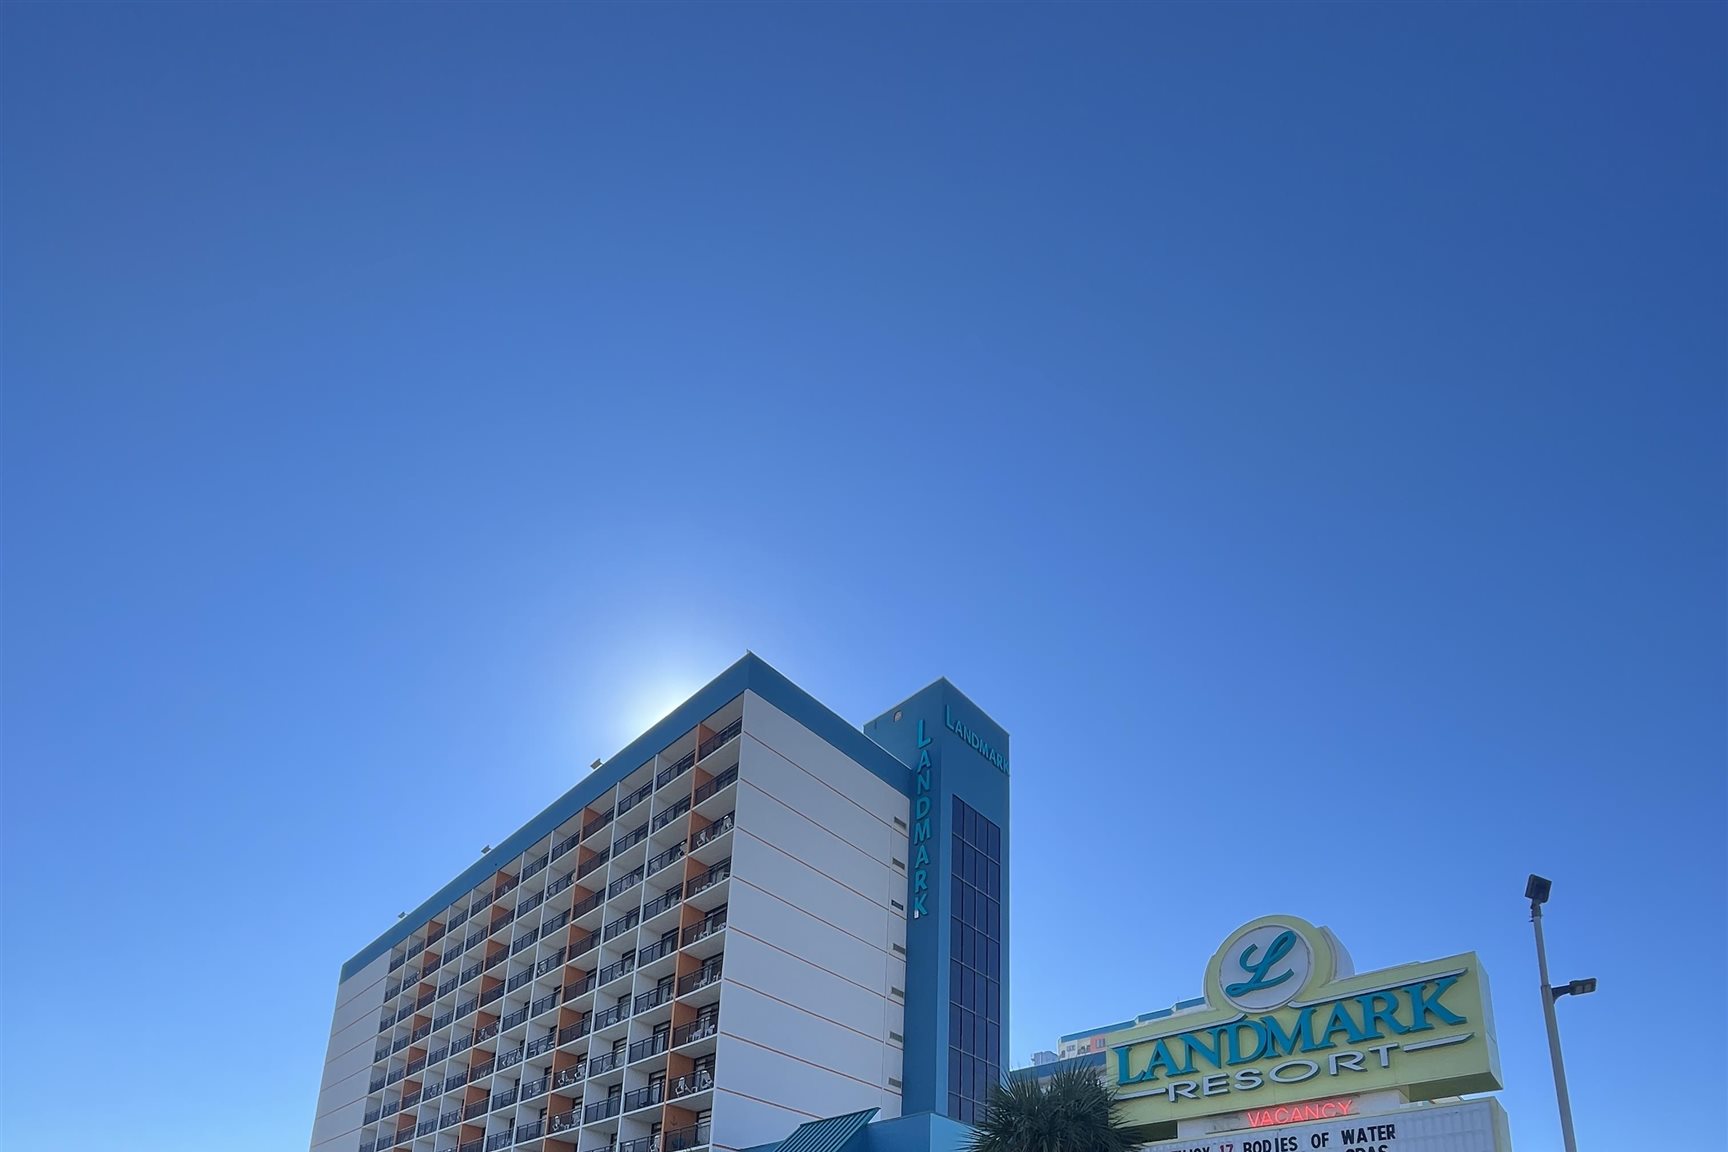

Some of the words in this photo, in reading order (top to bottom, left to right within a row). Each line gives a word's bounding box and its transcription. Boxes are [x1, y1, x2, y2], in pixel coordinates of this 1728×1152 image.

[945, 704, 1010, 777] LANDMARK
[914, 719, 932, 916] LANDMARK
[1112, 975, 1467, 1085] LANDMARK
[1168, 1043, 1400, 1103] RESORT
[1247, 1100, 1354, 1128] VACANCY
[1311, 1132, 1330, 1149] OF
[1341, 1124, 1396, 1146] WATER
